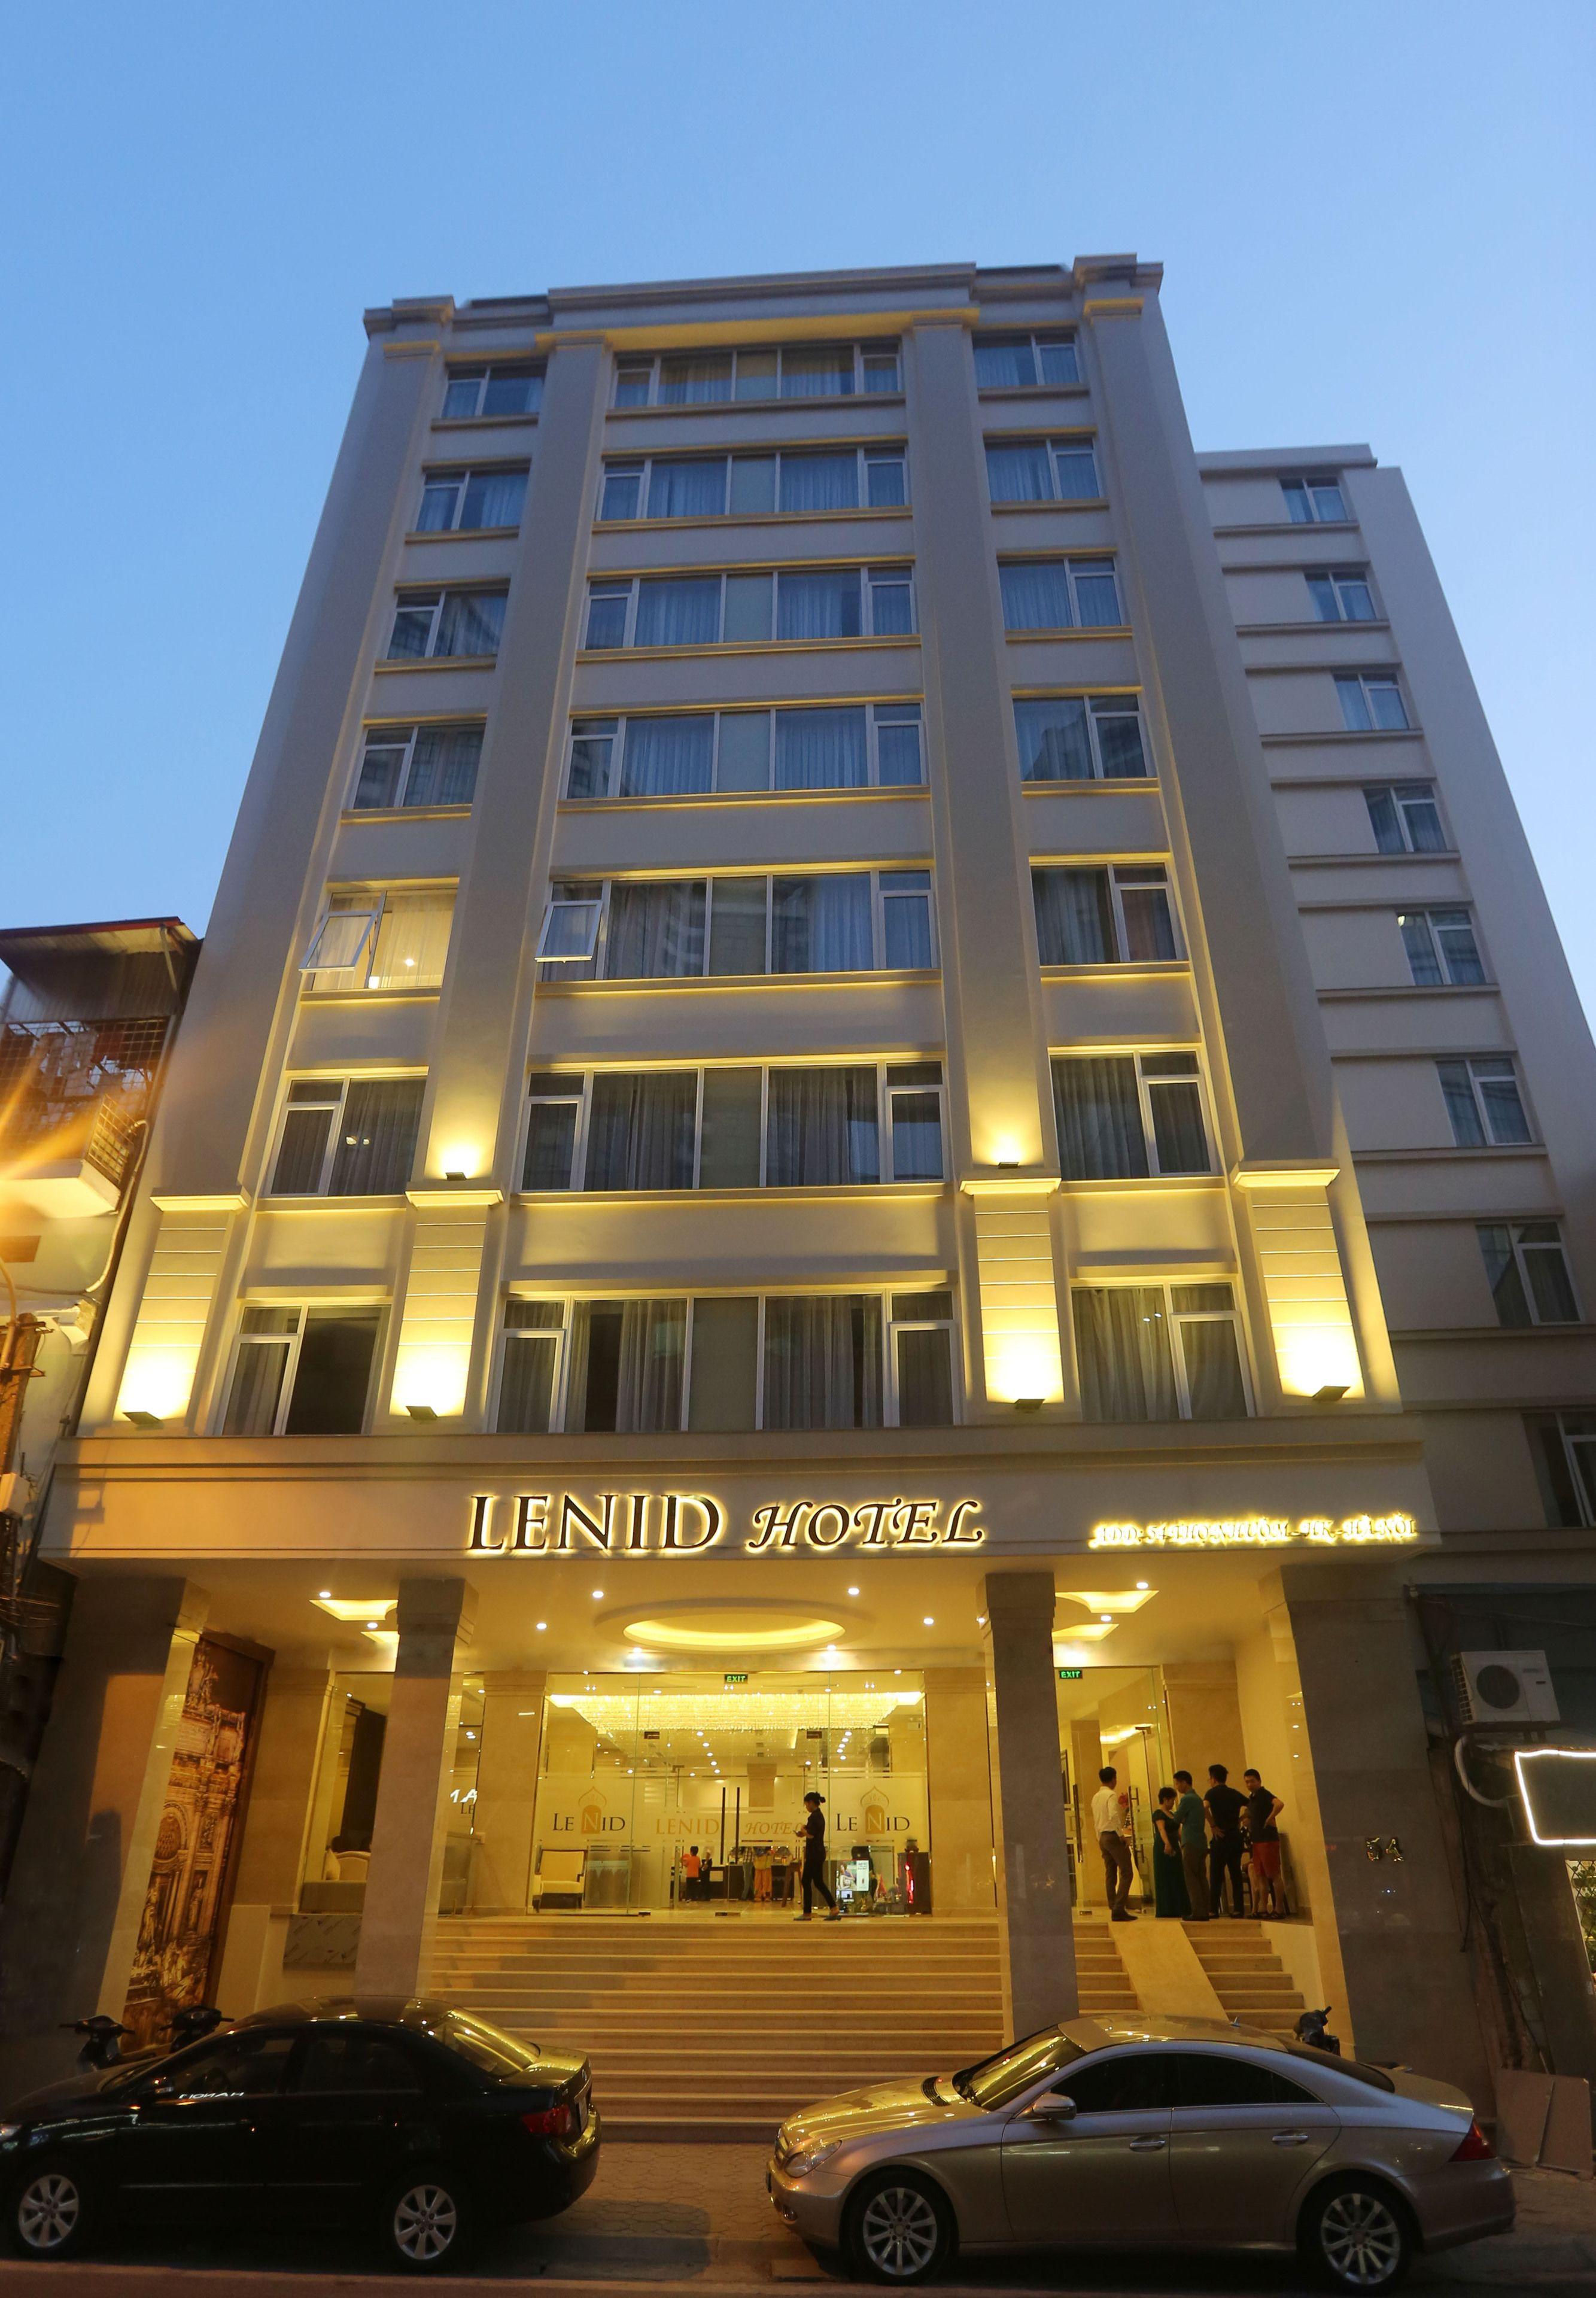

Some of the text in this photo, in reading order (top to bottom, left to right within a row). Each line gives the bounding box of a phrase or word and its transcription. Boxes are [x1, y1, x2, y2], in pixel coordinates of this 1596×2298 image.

[466, 1493, 984, 1551] LENID HOTEL
[1089, 1524, 1144, 1548] ADD:
[655, 1818, 719, 1835] LENID
[1366, 1836, 1405, 1862] 54
